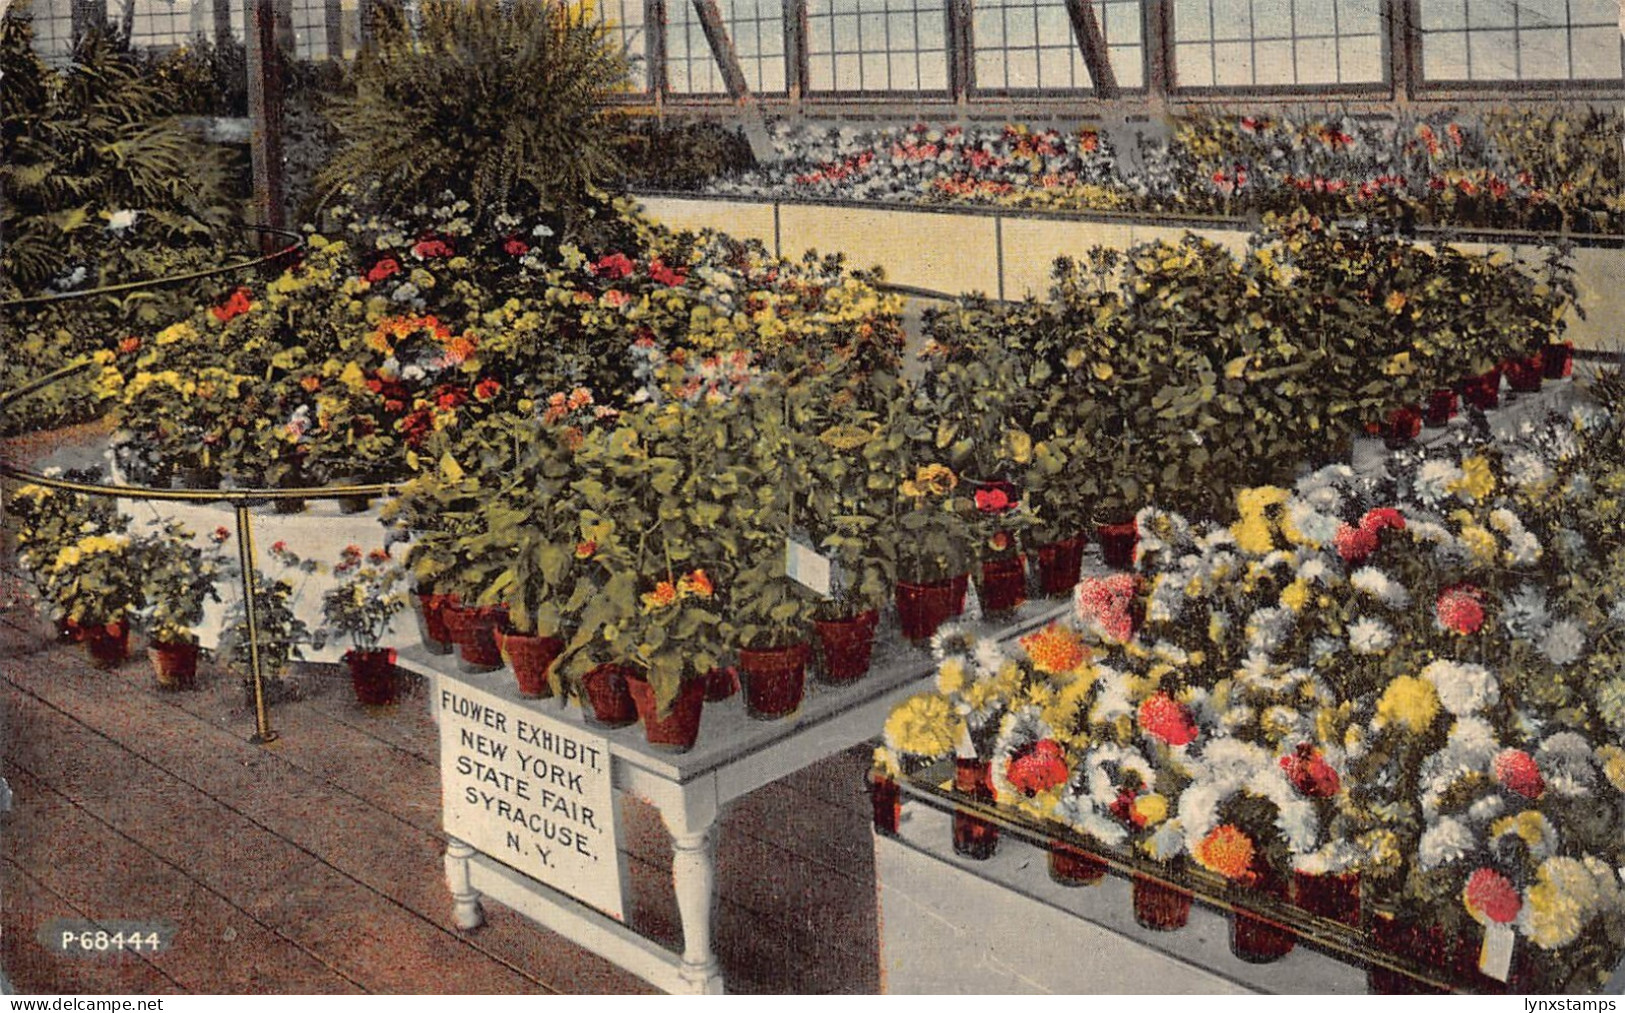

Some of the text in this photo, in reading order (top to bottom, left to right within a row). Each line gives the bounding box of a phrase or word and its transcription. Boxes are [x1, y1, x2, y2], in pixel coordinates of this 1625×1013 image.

[442, 690, 602, 773] FLOWER EXHIBIT,
[461, 728, 583, 795] NEW YORK
[456, 756, 602, 834] STATE FAIR,
[465, 786, 598, 861] SYRACUSE,
